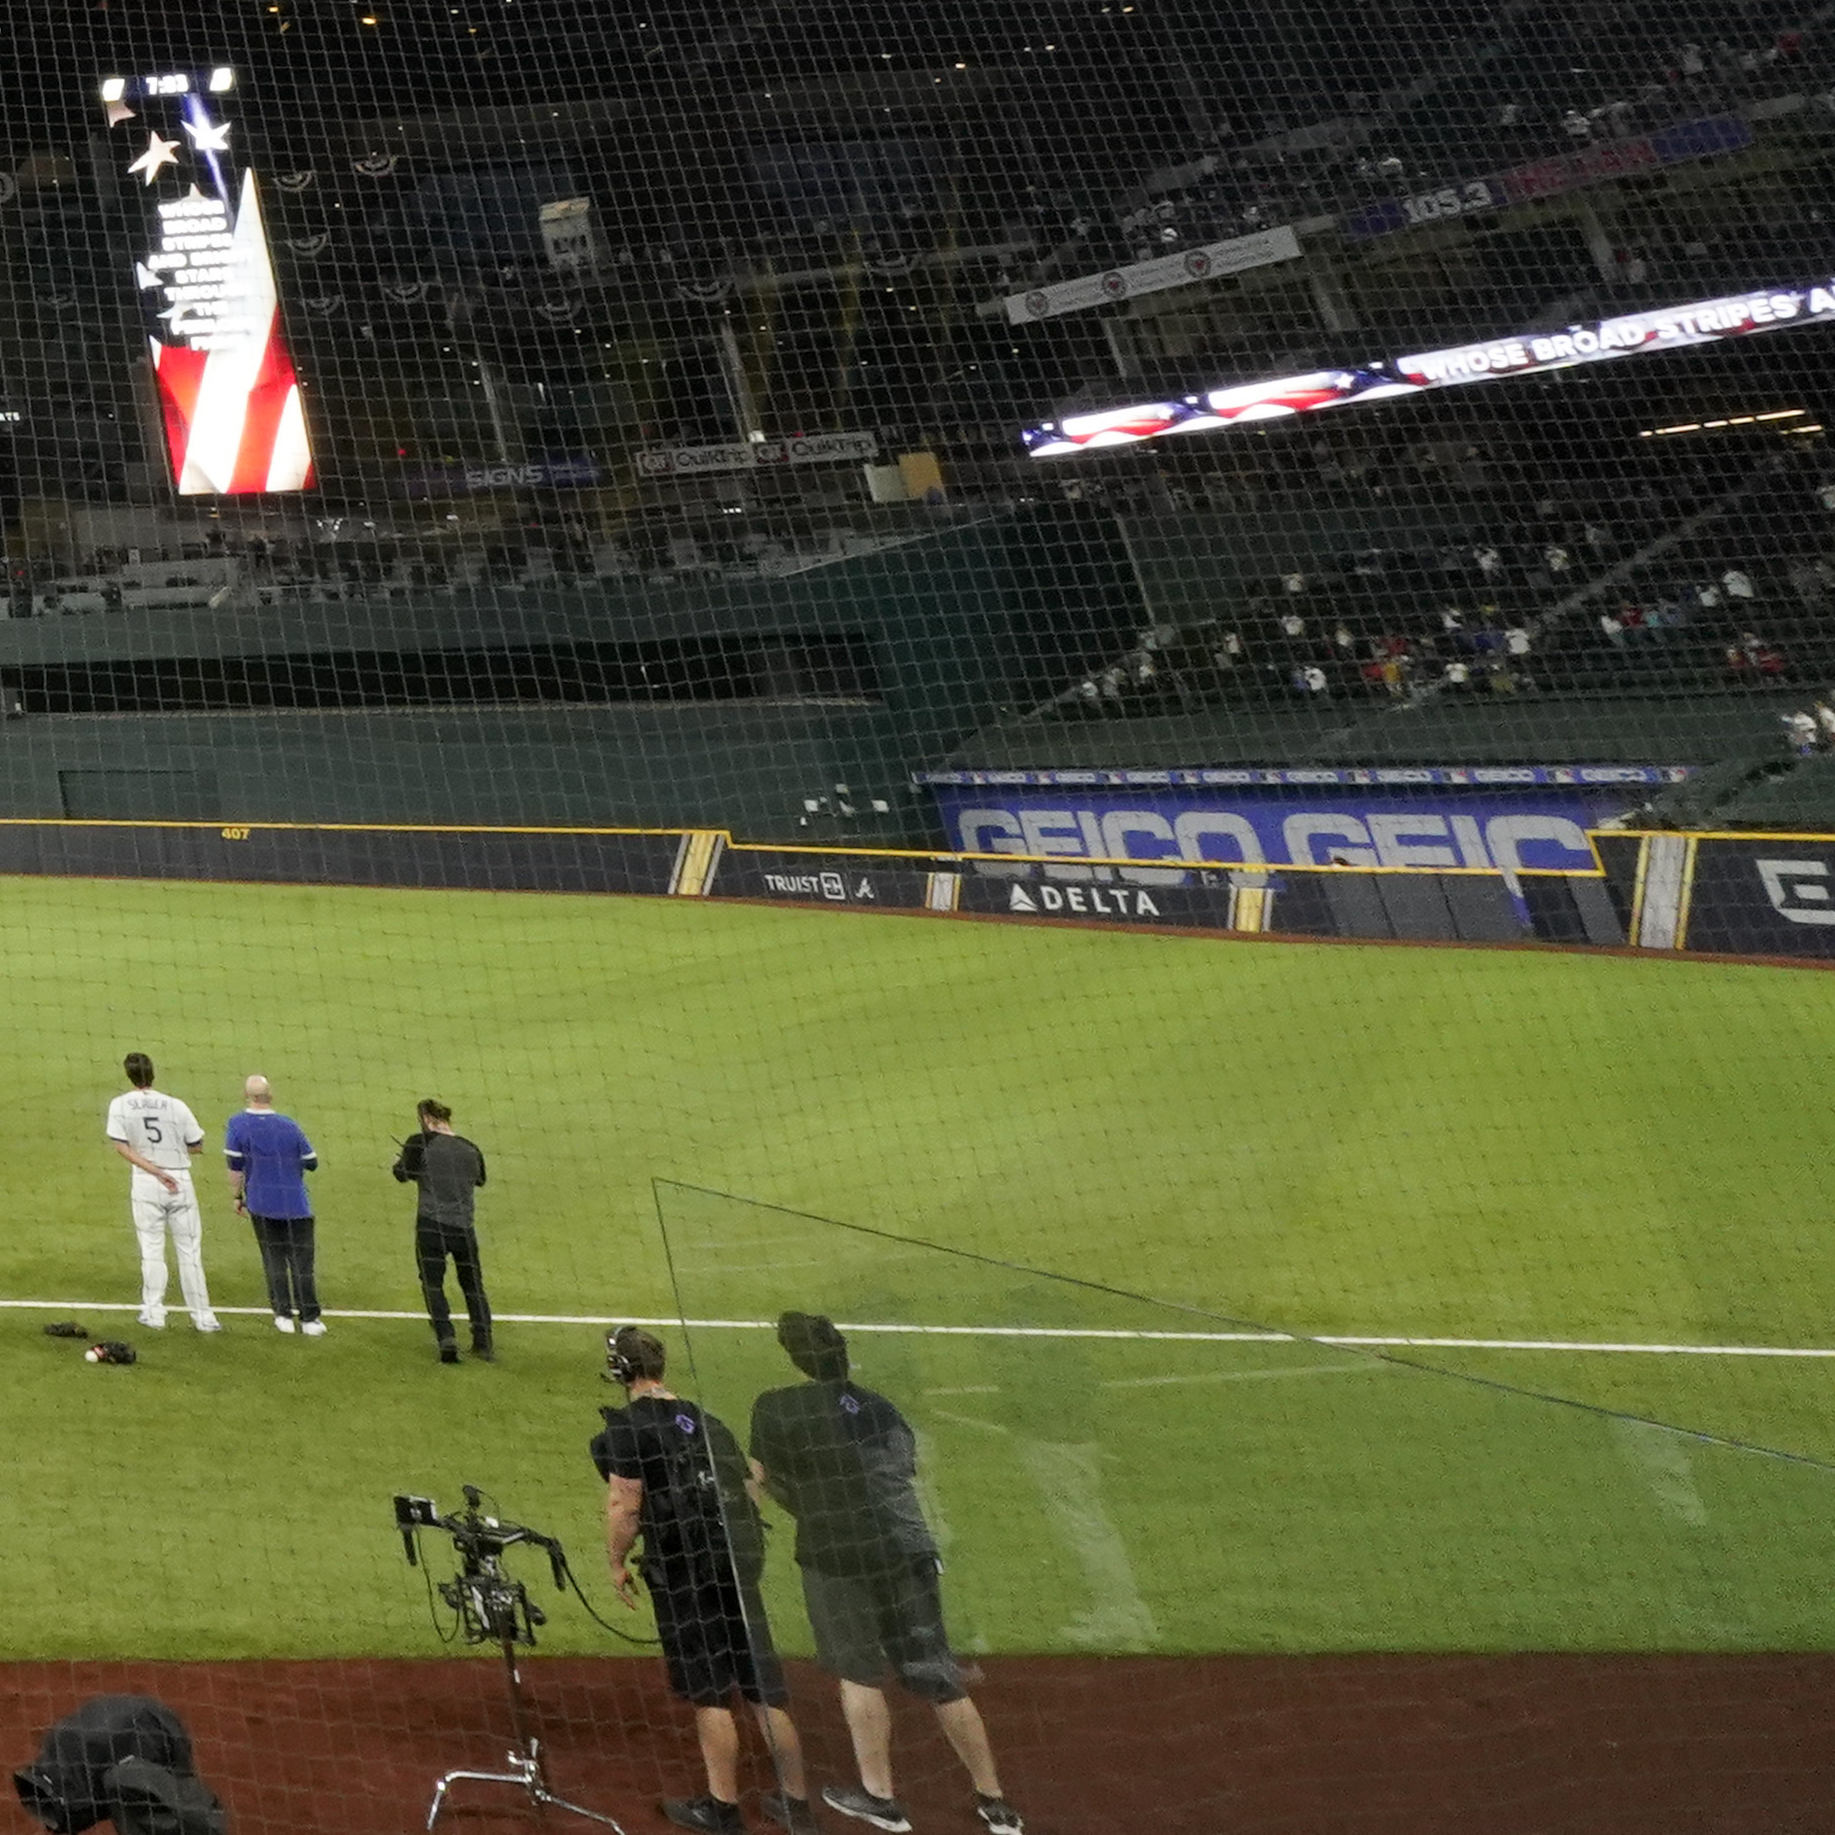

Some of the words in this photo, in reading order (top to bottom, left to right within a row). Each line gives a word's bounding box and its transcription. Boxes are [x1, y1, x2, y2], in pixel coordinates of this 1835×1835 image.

[1402, 182, 1493, 223] 105.3
[1418, 344, 1530, 380] WHOSE
[1531, 324, 1647, 361] BROAD
[1656, 294, 1799, 340] STRIPES
[221, 827, 251, 840] 407
[957, 808, 1266, 886] GEICO
[764, 874, 820, 894] TRUIST
[1040, 885, 1161, 917] DELTA
[142, 1116, 163, 1144] 5
